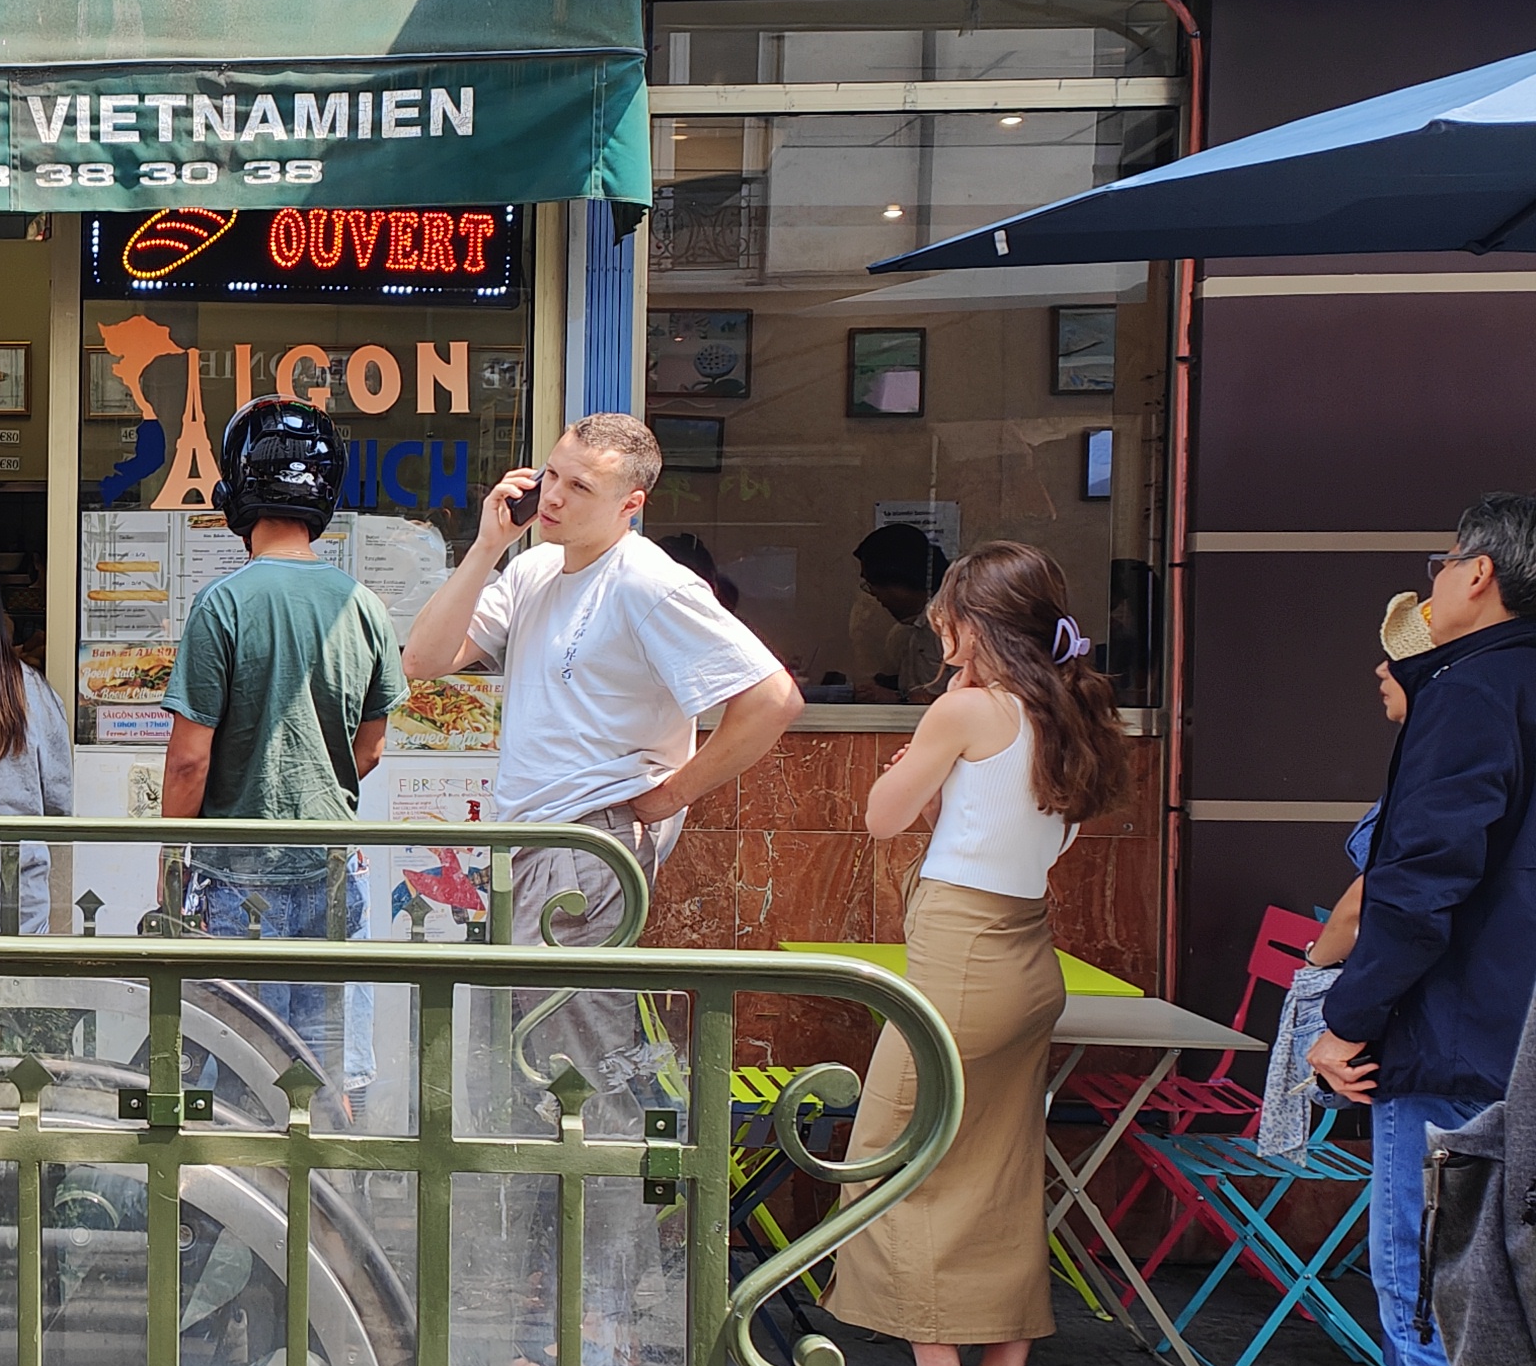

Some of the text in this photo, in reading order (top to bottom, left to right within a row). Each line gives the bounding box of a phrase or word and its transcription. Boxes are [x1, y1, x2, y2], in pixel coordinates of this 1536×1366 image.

[26, 87, 475, 145] VIETNAMIEN
[35, 162, 115, 189] 38
[139, 161, 219, 187] 30
[244, 160, 324, 185] 38
[269, 208, 495, 274] OUVERT
[135, 711, 172, 719] SANDWIC
[465, 778, 495, 792] PARI
